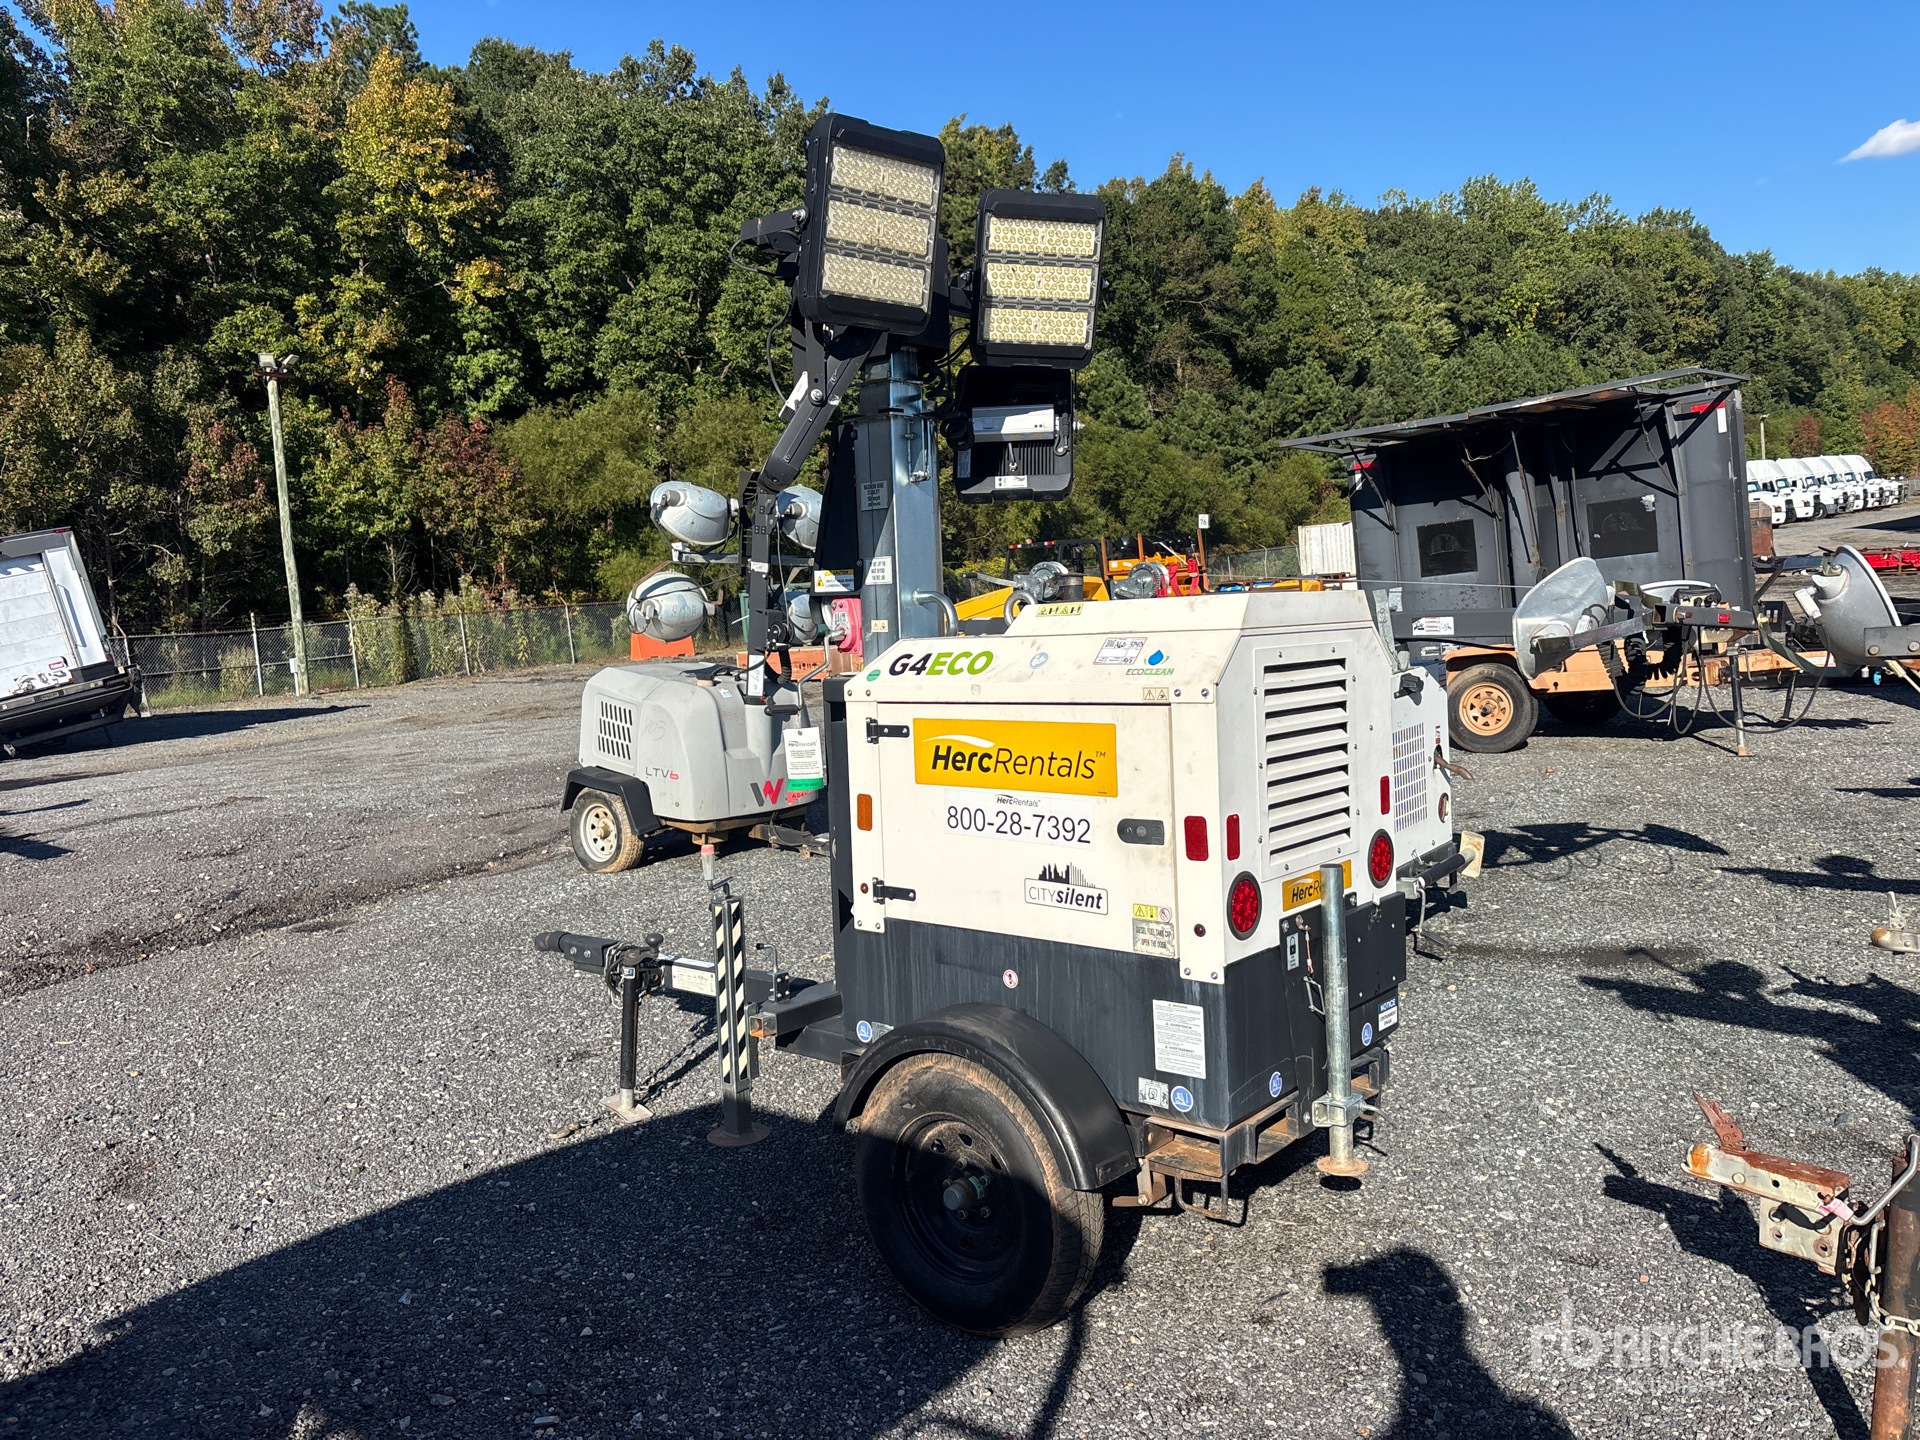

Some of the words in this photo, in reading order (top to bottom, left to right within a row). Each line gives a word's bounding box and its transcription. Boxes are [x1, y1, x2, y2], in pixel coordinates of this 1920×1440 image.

[889, 651, 994, 676] G4ECO
[645, 766, 679, 780] LTV6
[931, 745, 1096, 779] HercRentals
[996, 797, 1039, 807] HercRentals
[947, 806, 1091, 844] 800-28-7392
[1028, 886, 1103, 910] CITYsilent
[1380, 998, 1396, 1011] NOTICE
